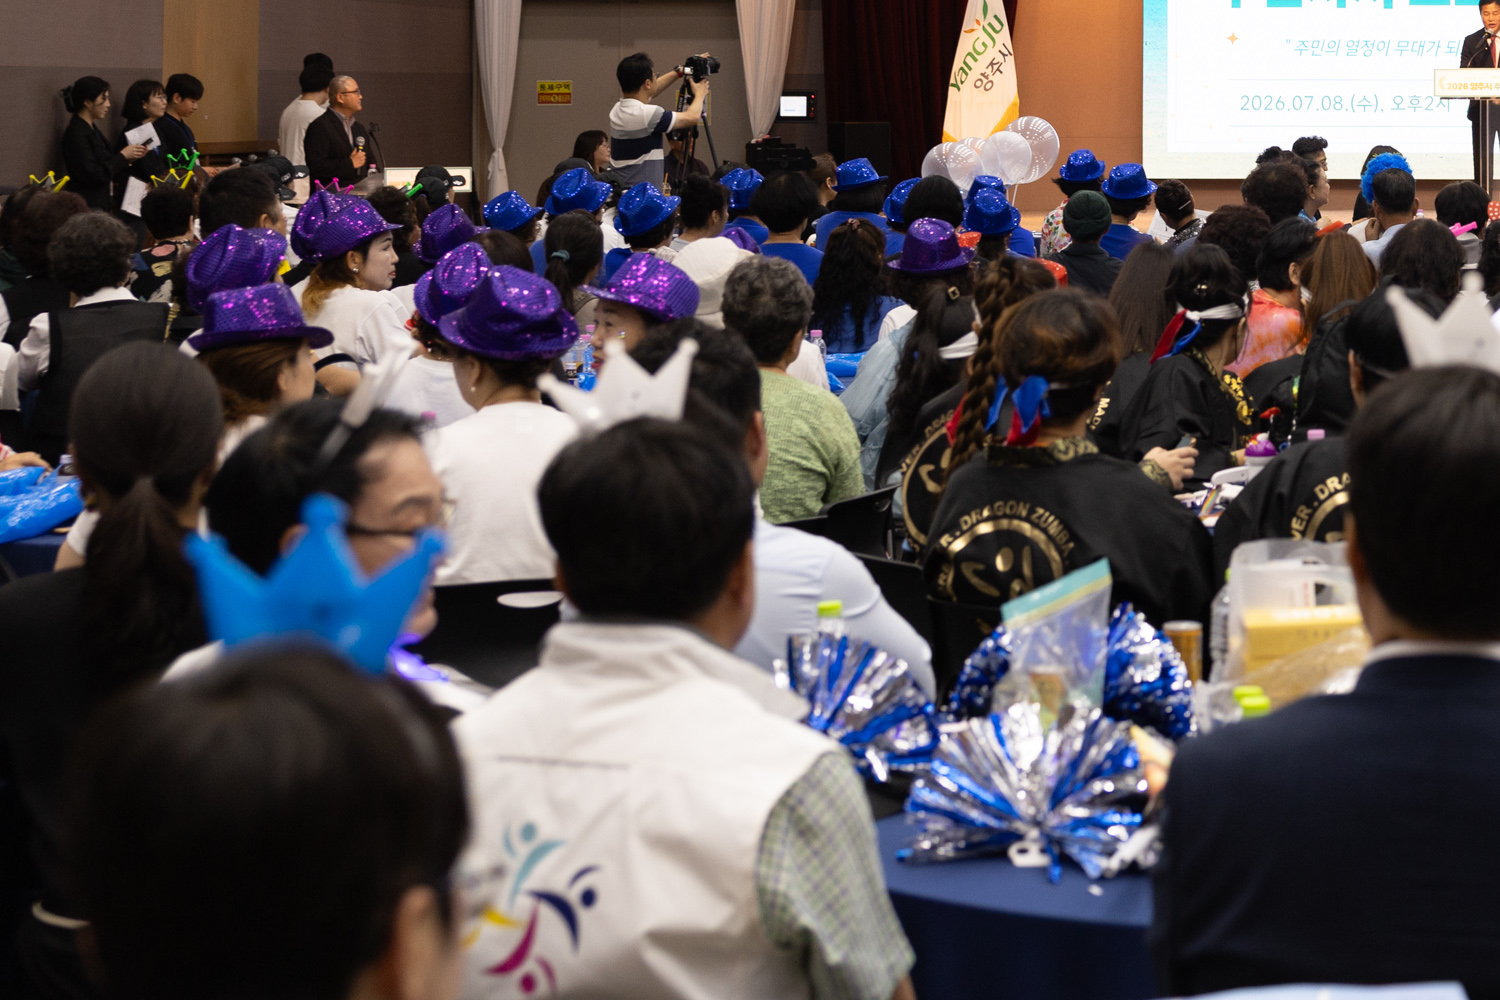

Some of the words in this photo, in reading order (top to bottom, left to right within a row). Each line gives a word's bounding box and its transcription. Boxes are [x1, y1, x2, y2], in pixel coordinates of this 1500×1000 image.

[1345, 39, 1391, 58] 열정이
[1394, 39, 1442, 57] 무대가
[973, 42, 1014, 92] 양주시
[1390, 94, 1450, 113] 오후2시
[959, 500, 1031, 530] DRAGON
[1030, 506, 1076, 558] ZUMBA
